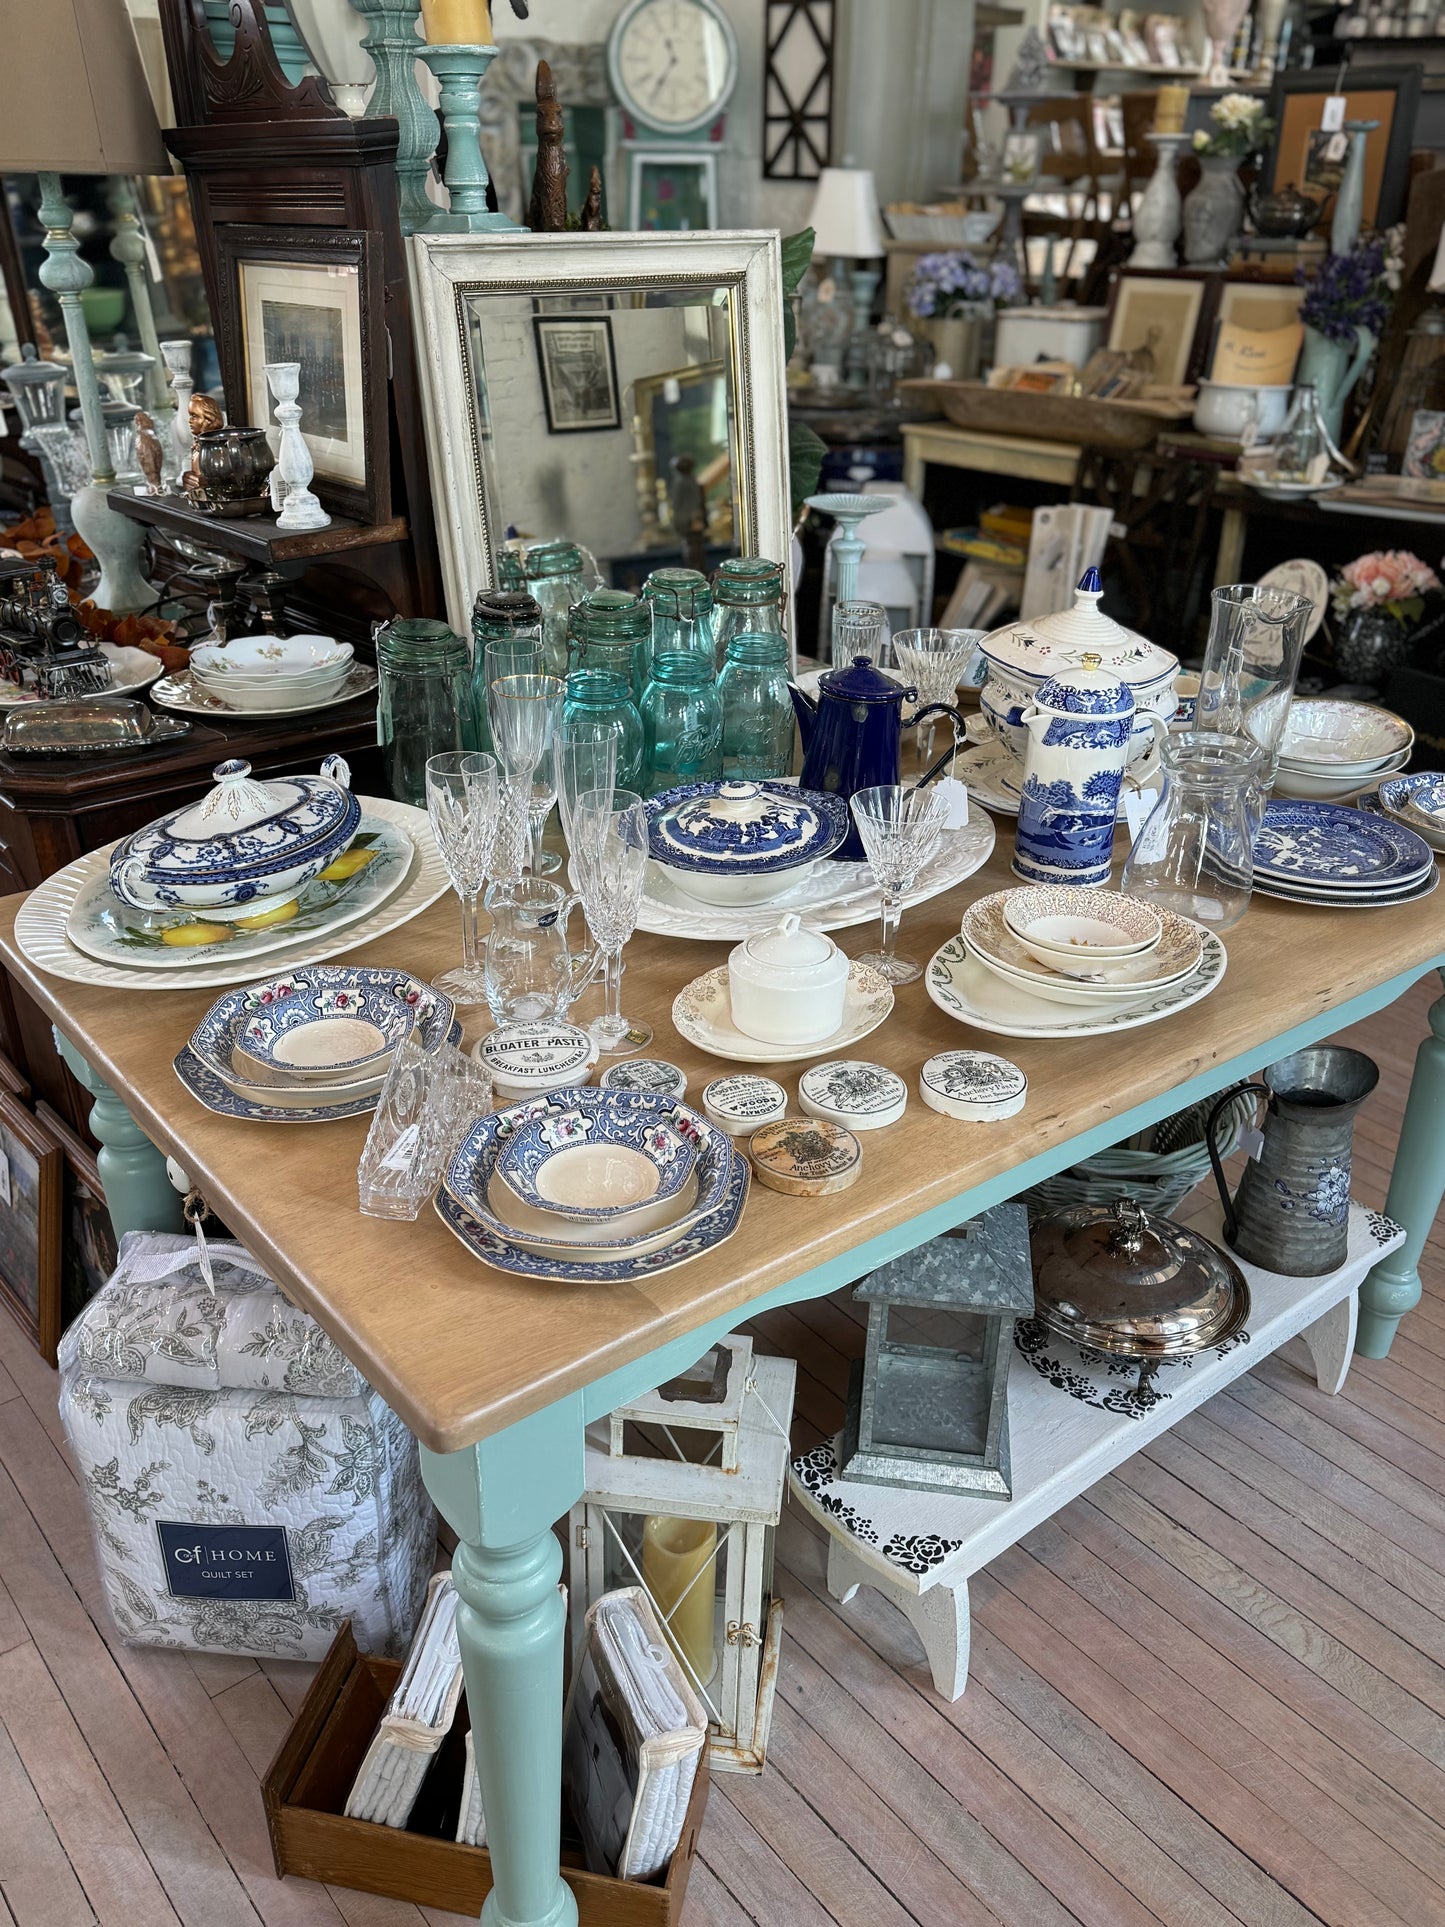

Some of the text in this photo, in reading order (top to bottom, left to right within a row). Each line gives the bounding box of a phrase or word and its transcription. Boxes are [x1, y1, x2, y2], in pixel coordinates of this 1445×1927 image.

[485, 1038, 585, 1054] BLOATER PASTE
[490, 1056, 535, 1074] BREAKFAST
[538, 1056, 579, 1074] LUNCHEON
[958, 1085, 994, 1099] Anchovy
[741, 1103, 778, 1115] PLYMOUTH
[789, 1160, 832, 1172] Anchovy
[211, 1549, 277, 1562] HOME
[201, 1570, 254, 1579] QUILT SET
